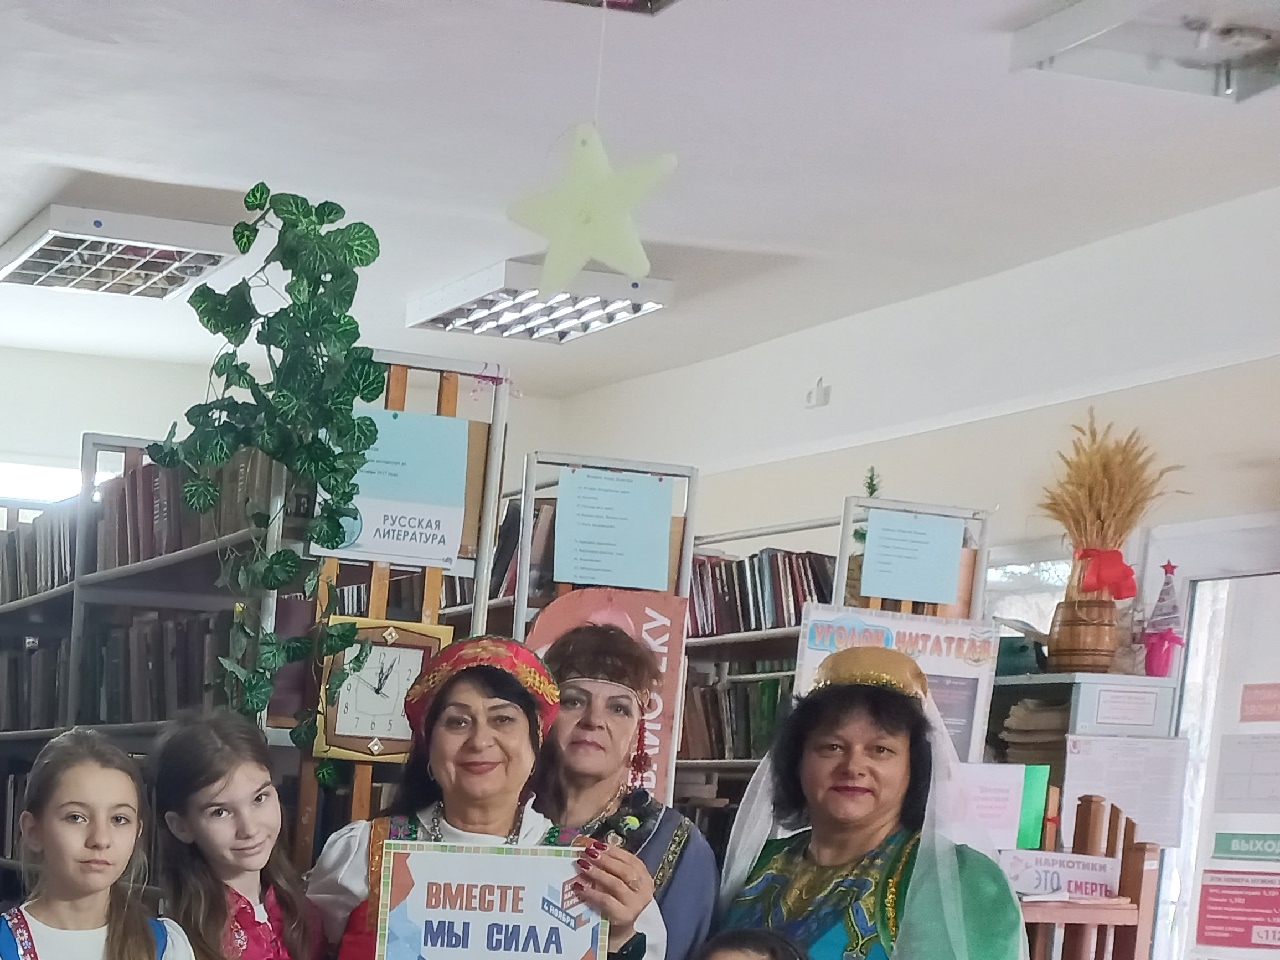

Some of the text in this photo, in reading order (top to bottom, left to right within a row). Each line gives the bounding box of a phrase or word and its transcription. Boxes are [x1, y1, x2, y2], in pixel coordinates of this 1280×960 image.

[383, 514, 441, 531] РУССКАЯ
[373, 528, 446, 546] ЛИТЕРАТУРА
[406, 668, 412, 681] 2
[343, 702, 349, 715] 8
[354, 716, 360, 729] 7
[387, 719, 393, 731] 5
[1034, 857, 1108, 873] НАРКОТИКИ
[1033, 869, 1114, 897] ЭТО СМЕРТЬ
[425, 881, 525, 914] ВМЕСТЕ
[549, 905, 575, 929] НОЯБРЯ
[423, 920, 563, 955] МЫ СИЛА
